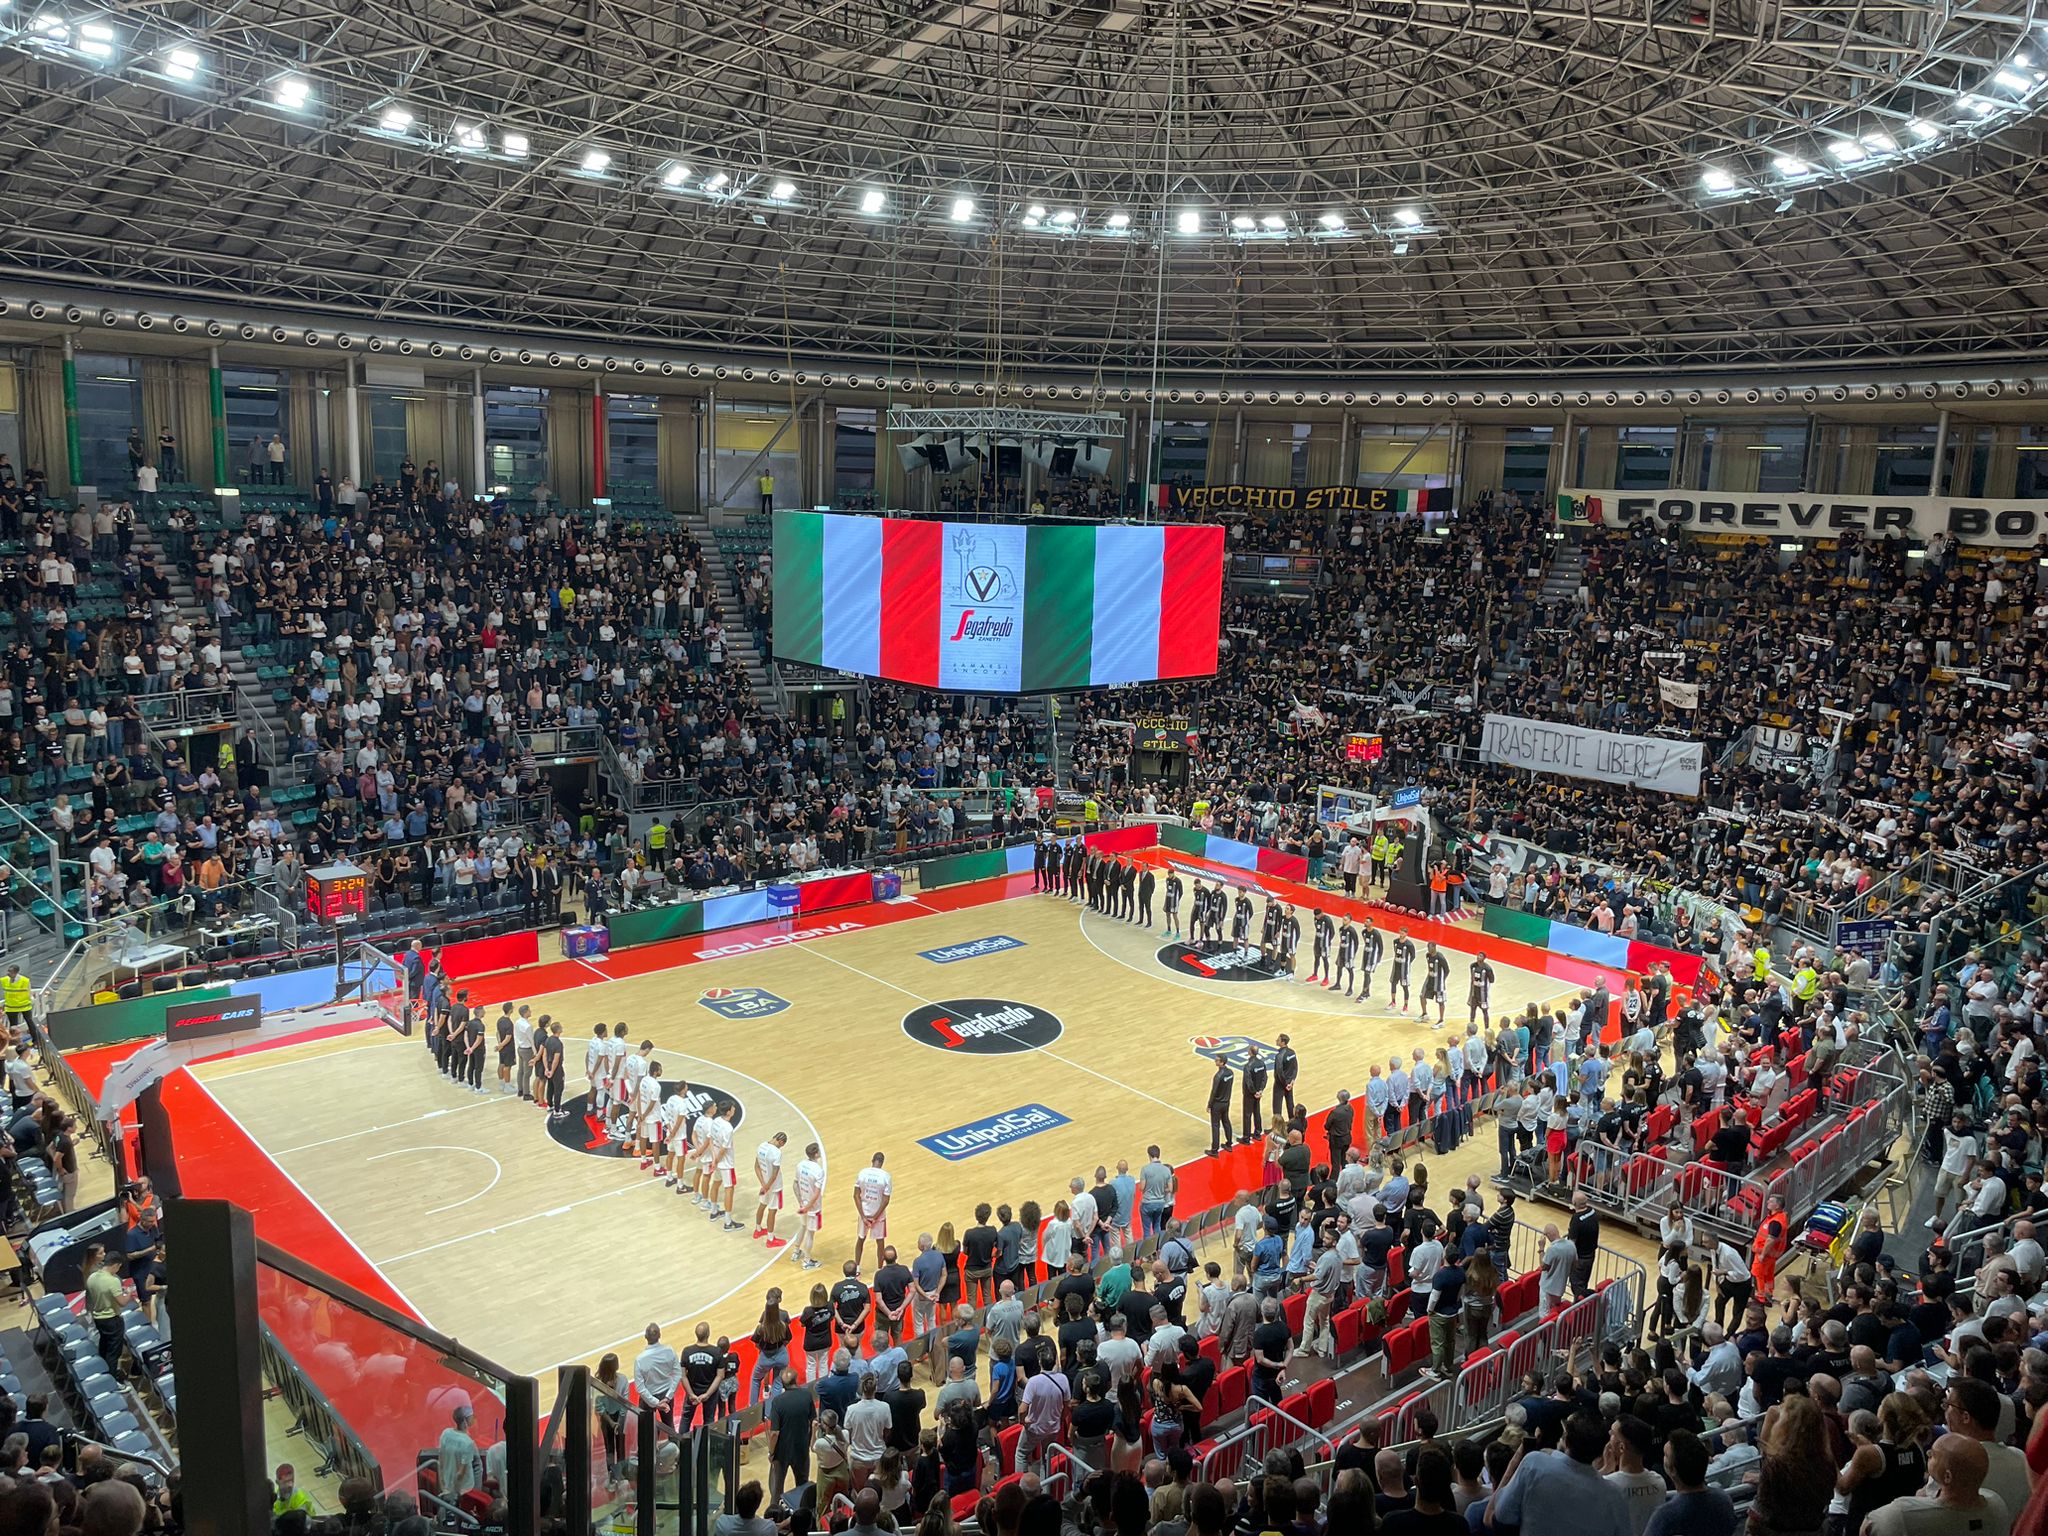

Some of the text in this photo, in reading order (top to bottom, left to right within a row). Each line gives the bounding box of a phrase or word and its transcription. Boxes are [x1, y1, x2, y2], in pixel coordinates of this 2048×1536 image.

[1177, 486, 1388, 511] VECCHIO STILE
[1618, 498, 1916, 534] FOREVER
[949, 609, 1014, 642] Segafredo
[1143, 740, 1179, 749] STILE
[1488, 721, 1586, 769] TRASFERTE
[333, 877, 365, 892] 3:24
[326, 889, 365, 917] 24
[693, 921, 866, 960] BOLOGNA
[928, 937, 1013, 960] UnipolSai
[721, 997, 779, 1014] LBA
[930, 1006, 1035, 1048] Segafredo
[934, 1108, 1052, 1151] UnipolSai
[999, 1118, 1059, 1141] ASSICURAZIONI
